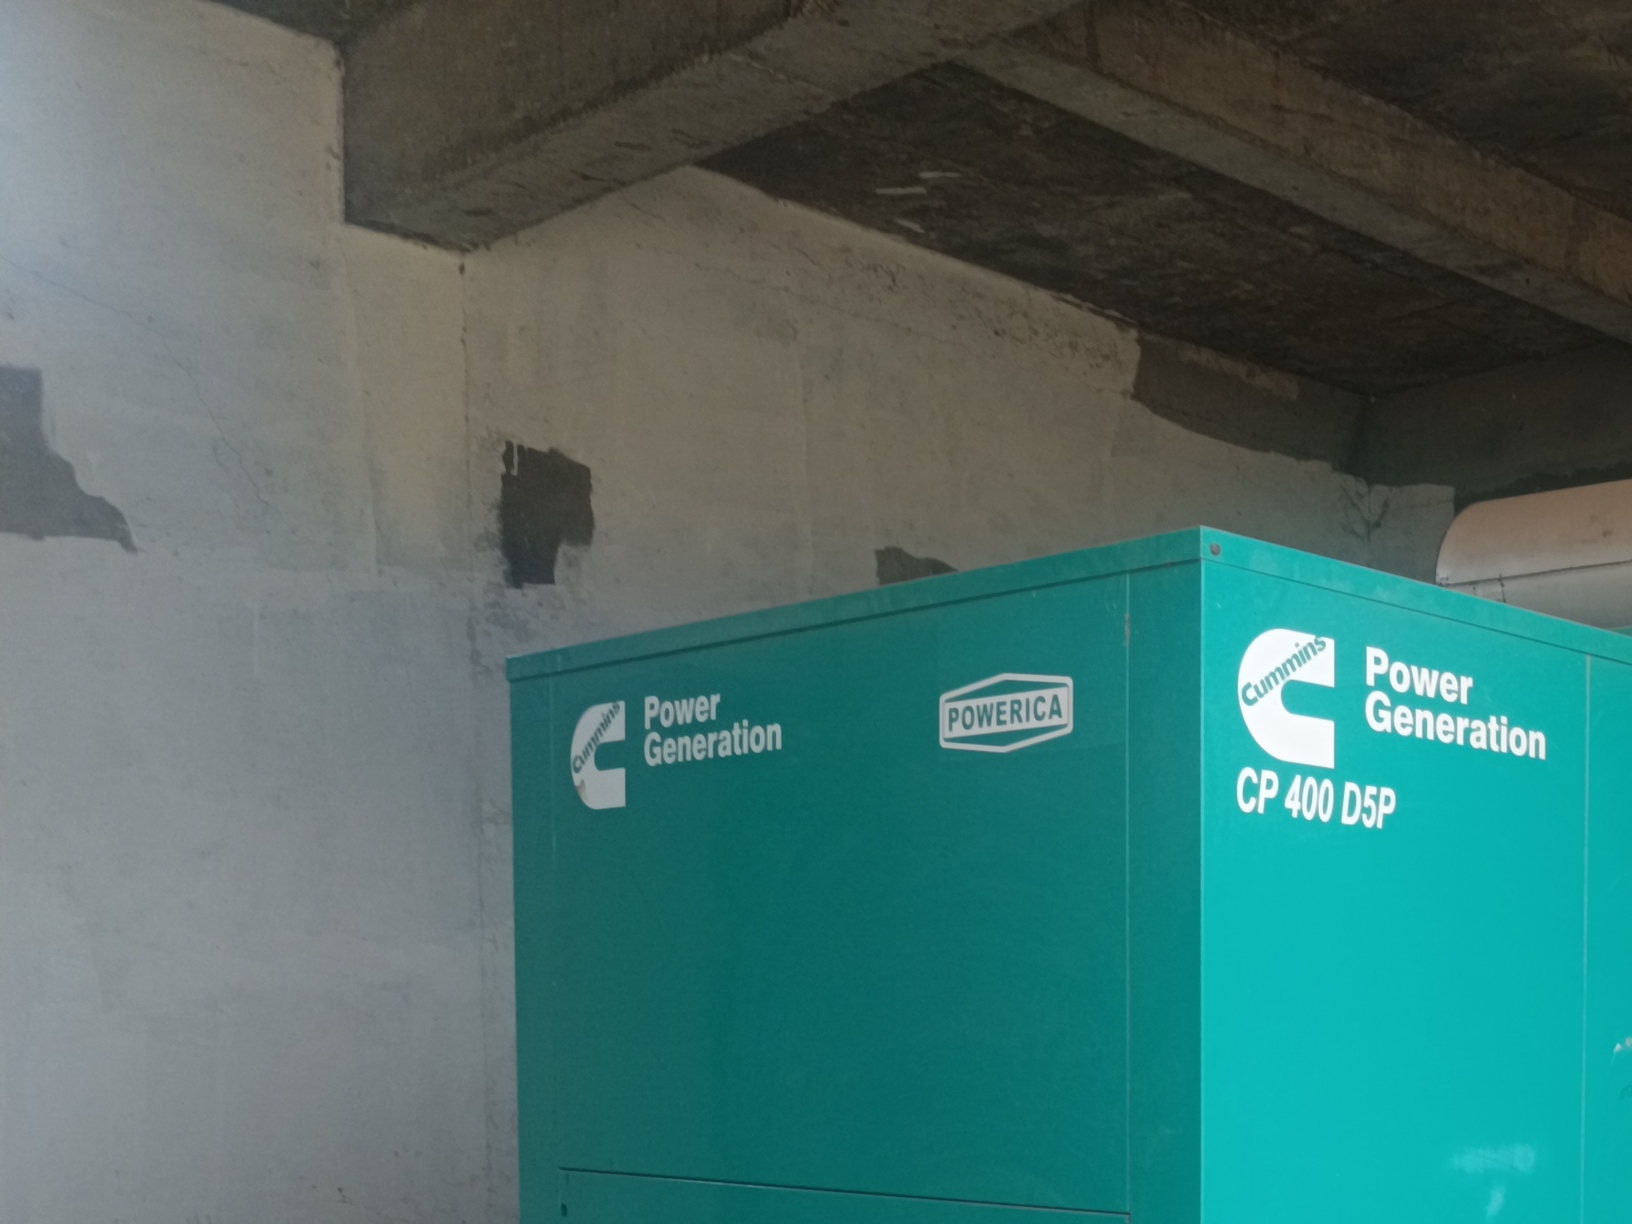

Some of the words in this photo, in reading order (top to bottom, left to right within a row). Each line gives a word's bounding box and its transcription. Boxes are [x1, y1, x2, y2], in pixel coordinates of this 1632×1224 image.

[1241, 635, 1327, 707] Cummins
[1366, 646, 1474, 704] Power
[571, 700, 621, 775] Cummins
[644, 692, 721, 730] Power
[947, 693, 1064, 732] POWERICA
[1365, 691, 1547, 760] Generation
[644, 720, 783, 767] Generation
[1237, 767, 1280, 814] CP
[1285, 774, 1335, 823] 400
[1341, 781, 1397, 829] D5P
